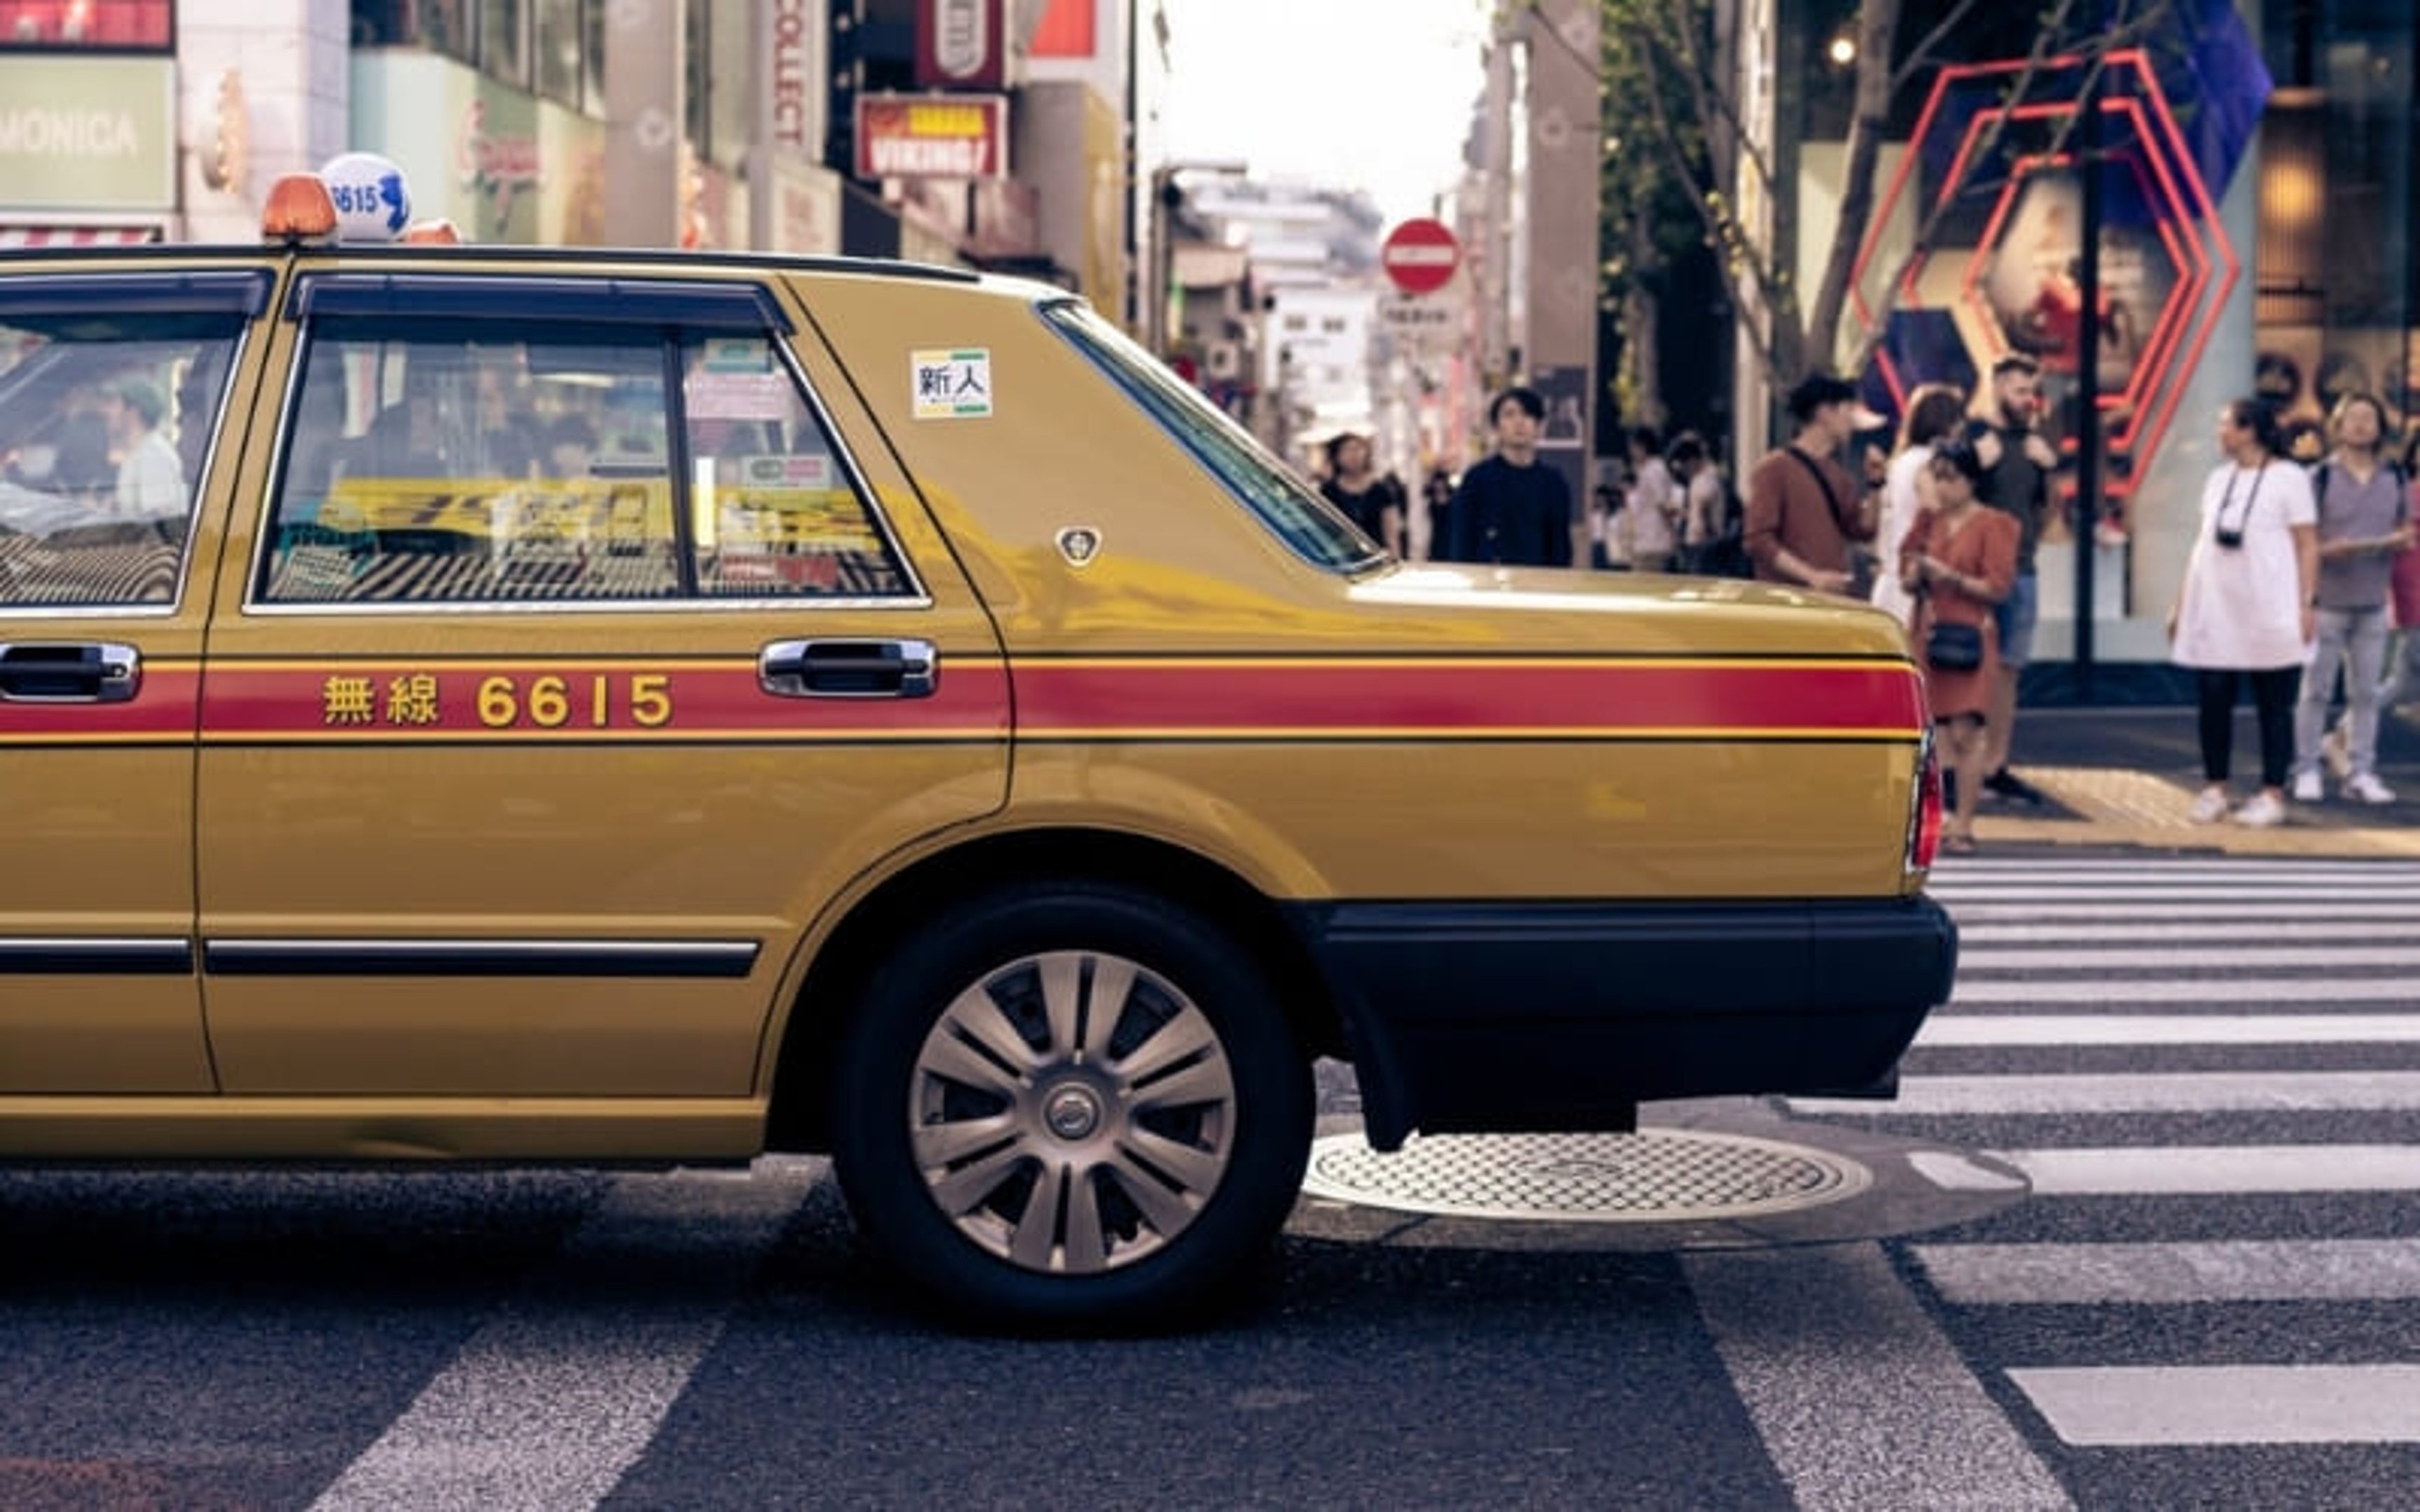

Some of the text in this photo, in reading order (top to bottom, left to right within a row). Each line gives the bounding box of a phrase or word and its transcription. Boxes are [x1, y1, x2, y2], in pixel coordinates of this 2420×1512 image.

[919, 365, 985, 396] 新人
[324, 676, 672, 725] 無線 6615
